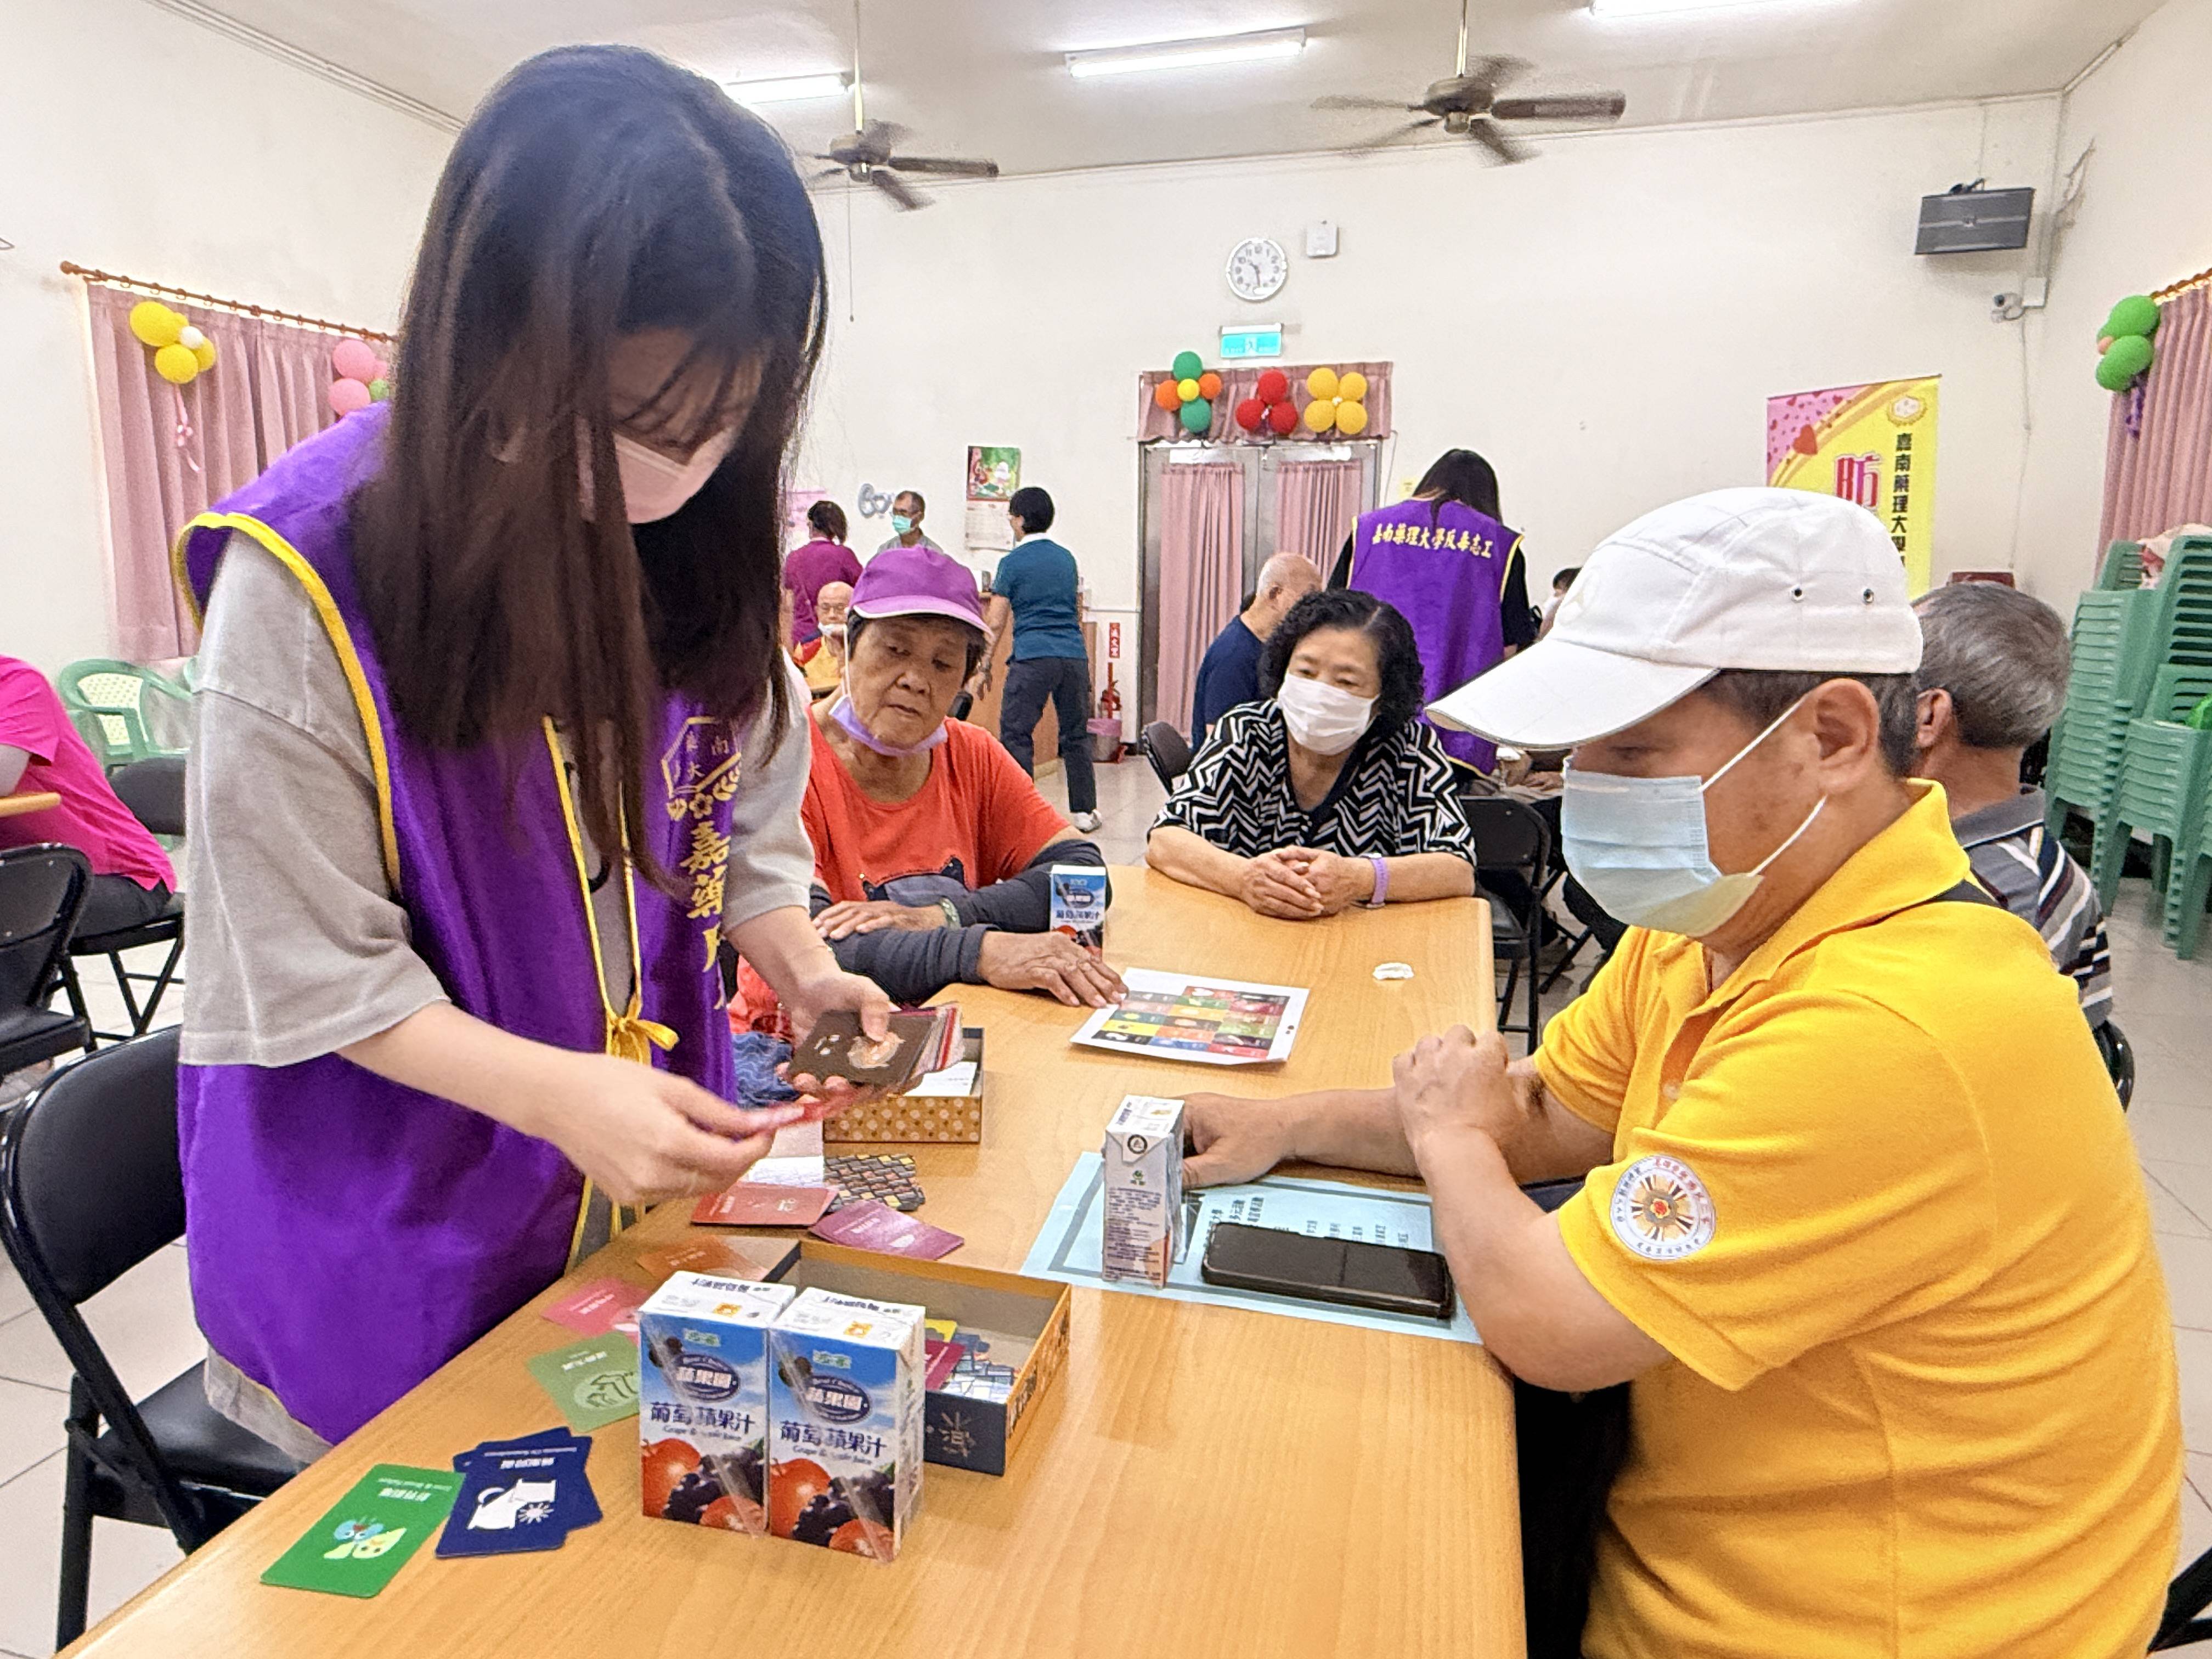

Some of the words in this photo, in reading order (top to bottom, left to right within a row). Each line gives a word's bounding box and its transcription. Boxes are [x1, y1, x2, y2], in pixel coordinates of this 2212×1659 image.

[1891, 433, 1912, 567] 嘉南藥理大學
